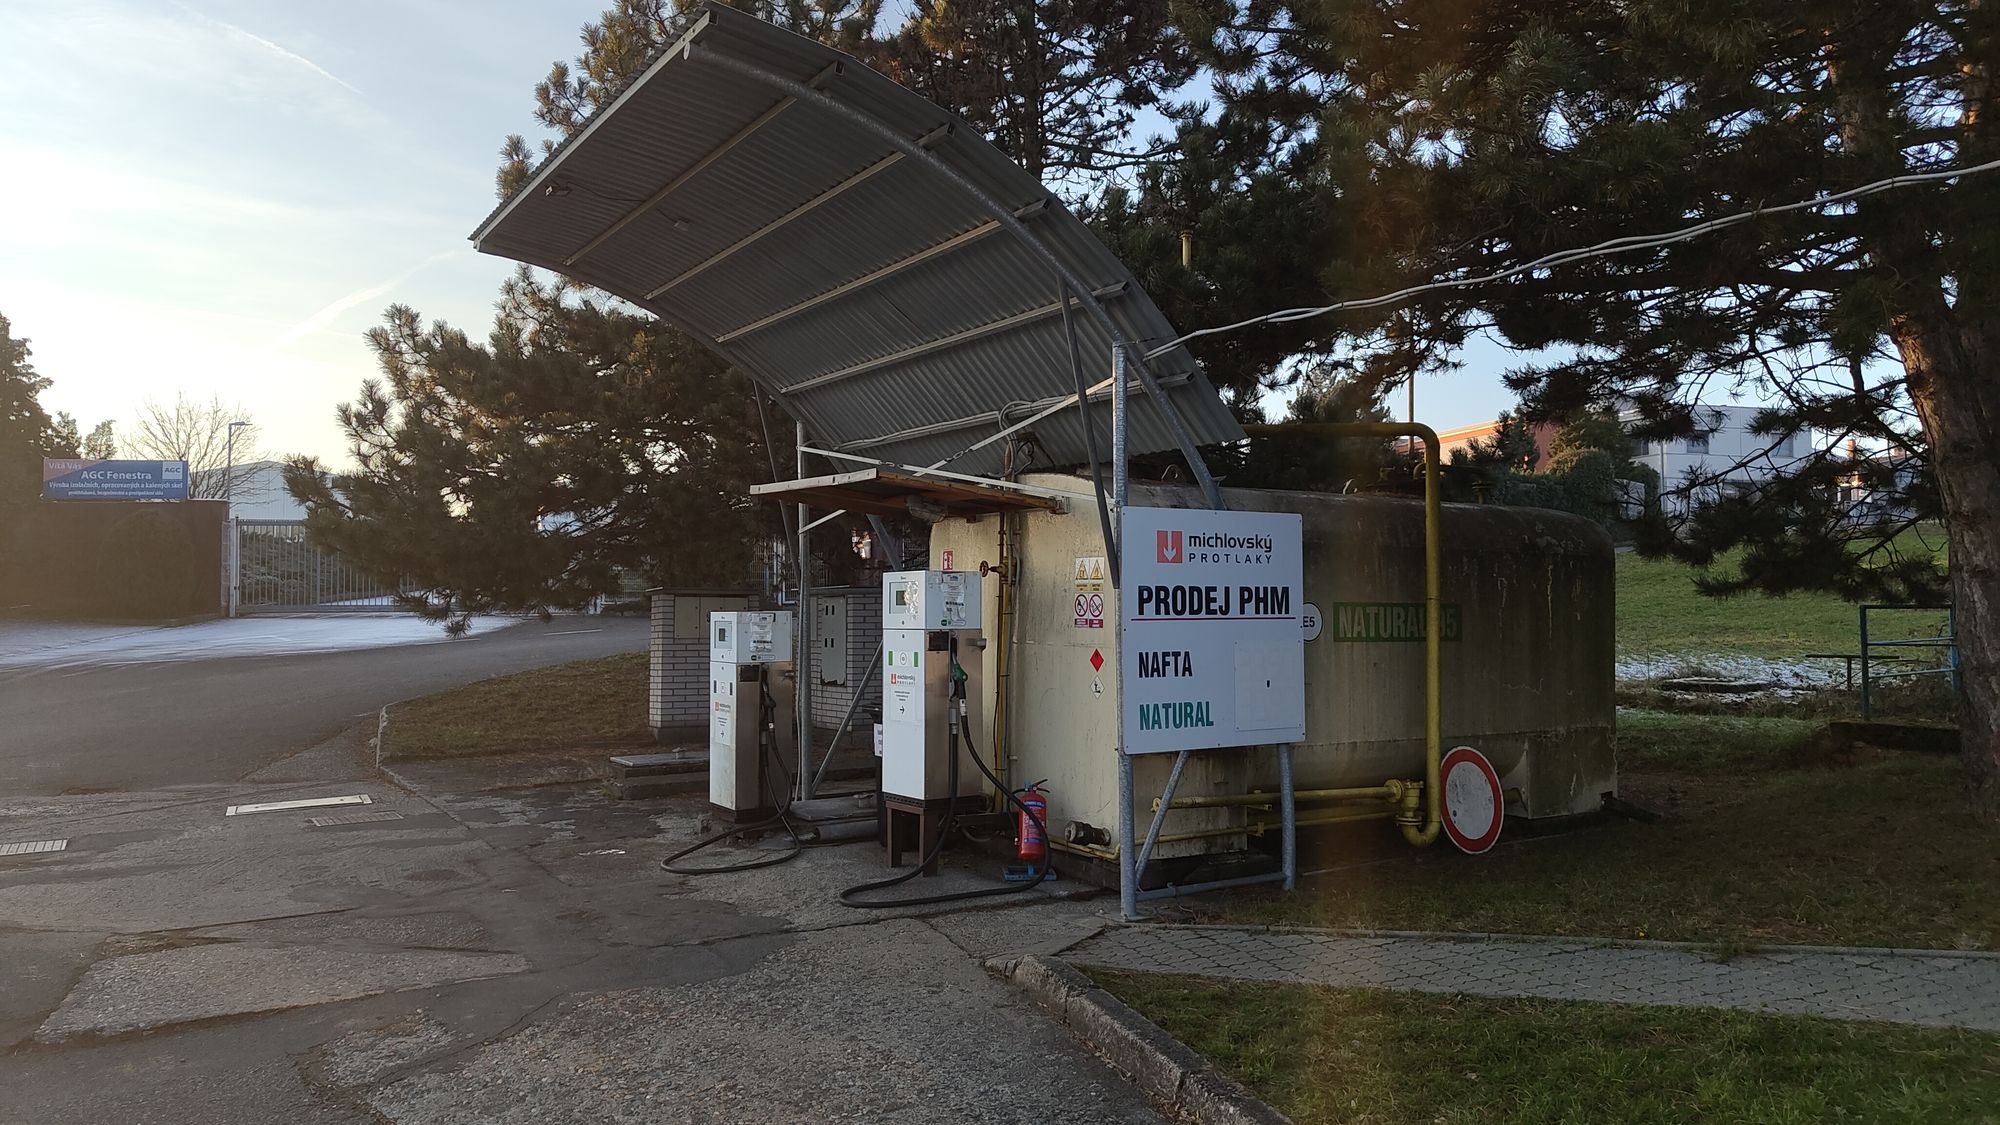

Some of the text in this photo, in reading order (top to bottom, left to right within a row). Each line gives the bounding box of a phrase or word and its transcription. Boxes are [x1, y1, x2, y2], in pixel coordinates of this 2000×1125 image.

[81, 470, 152, 480] AGC Fenestra
[1188, 532, 1272, 553] michlovský
[1189, 553, 1272, 565] PROTLAKY
[1138, 585, 1290, 616] PRODEJ PHM
[1302, 616, 1315, 629] E5
[1338, 605, 1428, 638] NATURAL
[1138, 651, 1193, 678] NAFTA
[1139, 701, 1214, 730] NATURAL
